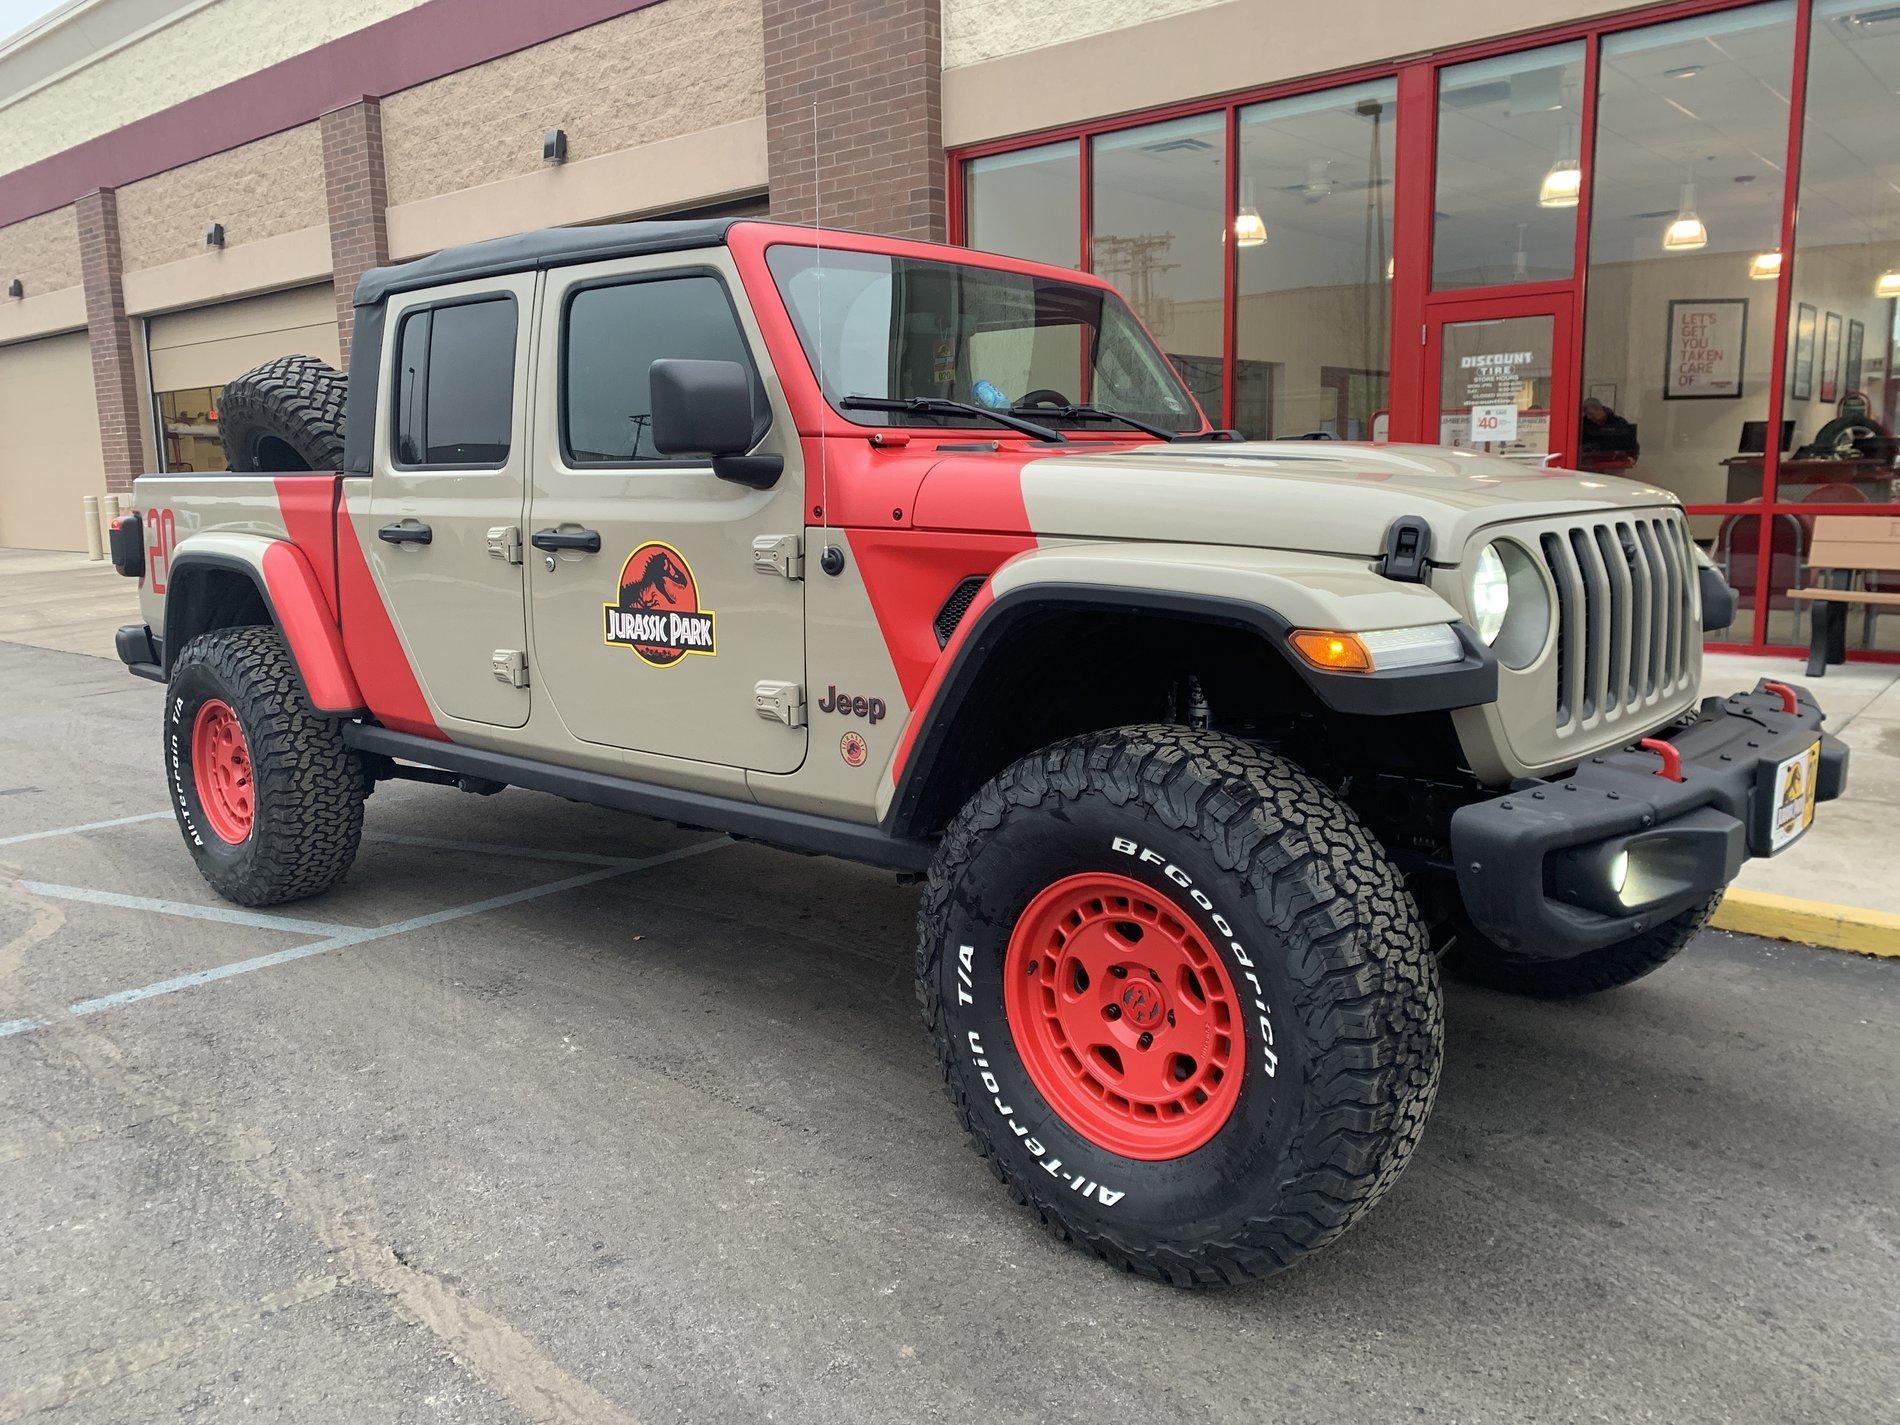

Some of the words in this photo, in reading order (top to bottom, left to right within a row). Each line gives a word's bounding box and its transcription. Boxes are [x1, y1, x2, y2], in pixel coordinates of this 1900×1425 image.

[1682, 312, 1717, 325] LET'S
[1681, 325, 1708, 337] GET
[1681, 338, 1709, 349] YOU
[1461, 352, 1532, 368] DISCOUNT
[1680, 350, 1724, 362] TAKEN
[1480, 366, 1512, 376] TIRE
[1679, 362, 1714, 374] CARE
[1678, 375, 1697, 387] OF
[133, 508, 176, 595] 20
[607, 608, 668, 643] JURASSIC
[670, 612, 713, 647] PARK
[172, 696, 185, 725] T/A
[818, 684, 886, 725] Jeep
[170, 734, 204, 847] All-Terrain
[1111, 836, 1280, 1079] BFGoodrich
[957, 944, 975, 1007] T/A
[968, 1031, 1126, 1208] All-Terrain
